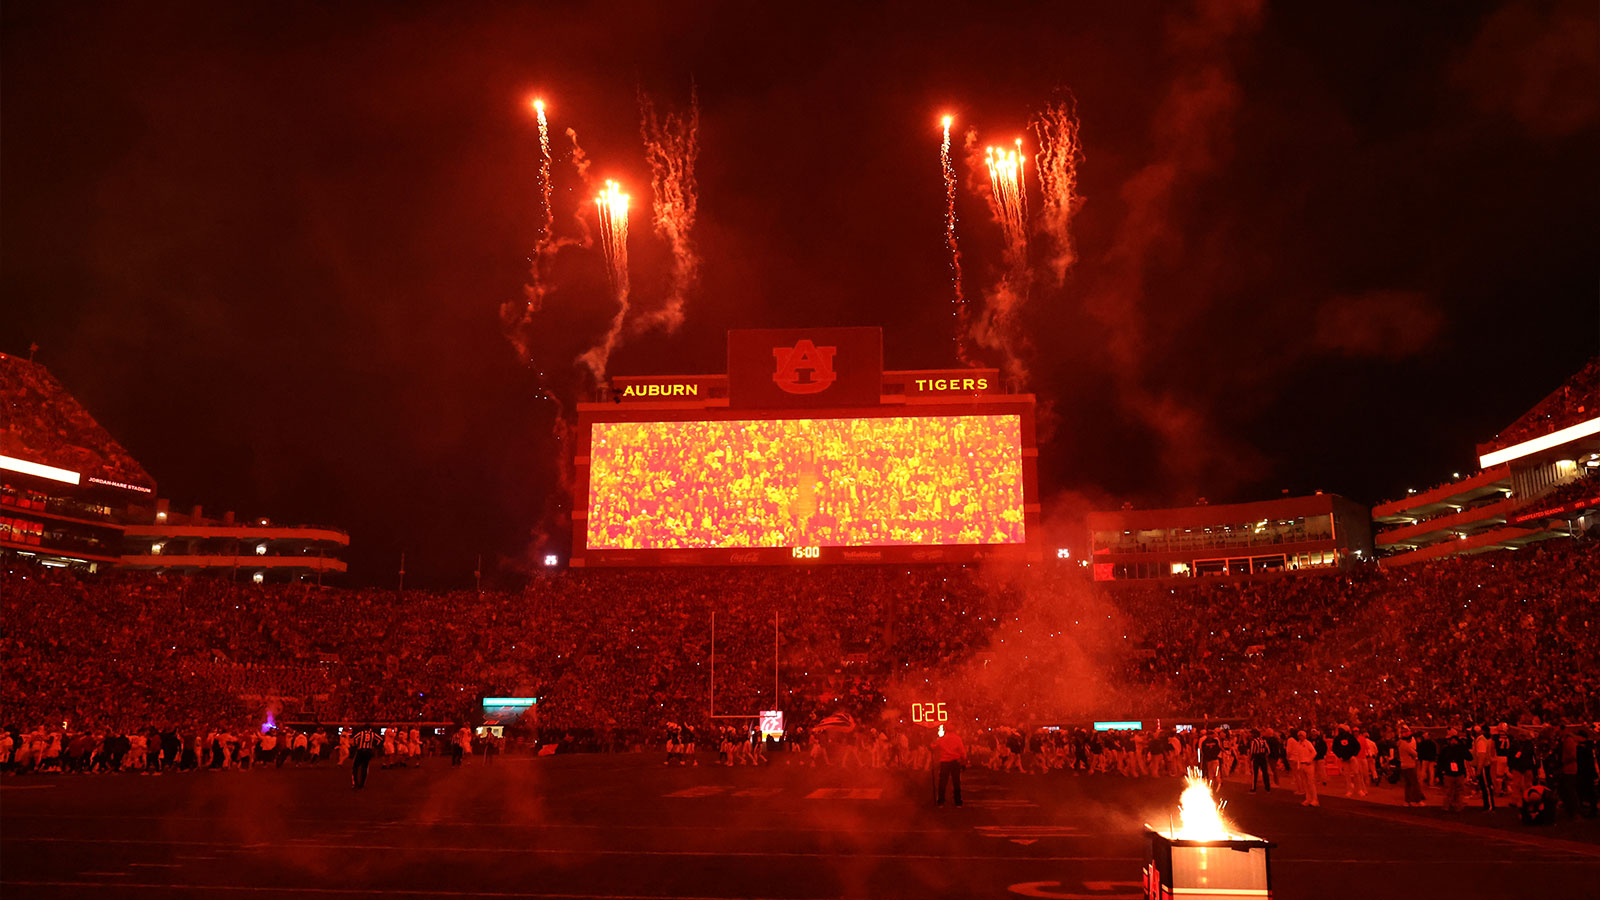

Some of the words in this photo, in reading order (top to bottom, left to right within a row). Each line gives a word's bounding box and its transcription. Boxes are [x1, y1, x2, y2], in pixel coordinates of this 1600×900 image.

[623, 384, 698, 396] AUBURN
[915, 379, 988, 391] TIGERS
[88, 477, 127, 488] JORDAN-HARE
[128, 485, 151, 493] STADIUM
[792, 547, 820, 558] 15:00
[1057, 548, 1070, 558] 25
[912, 703, 948, 722] 0:26
